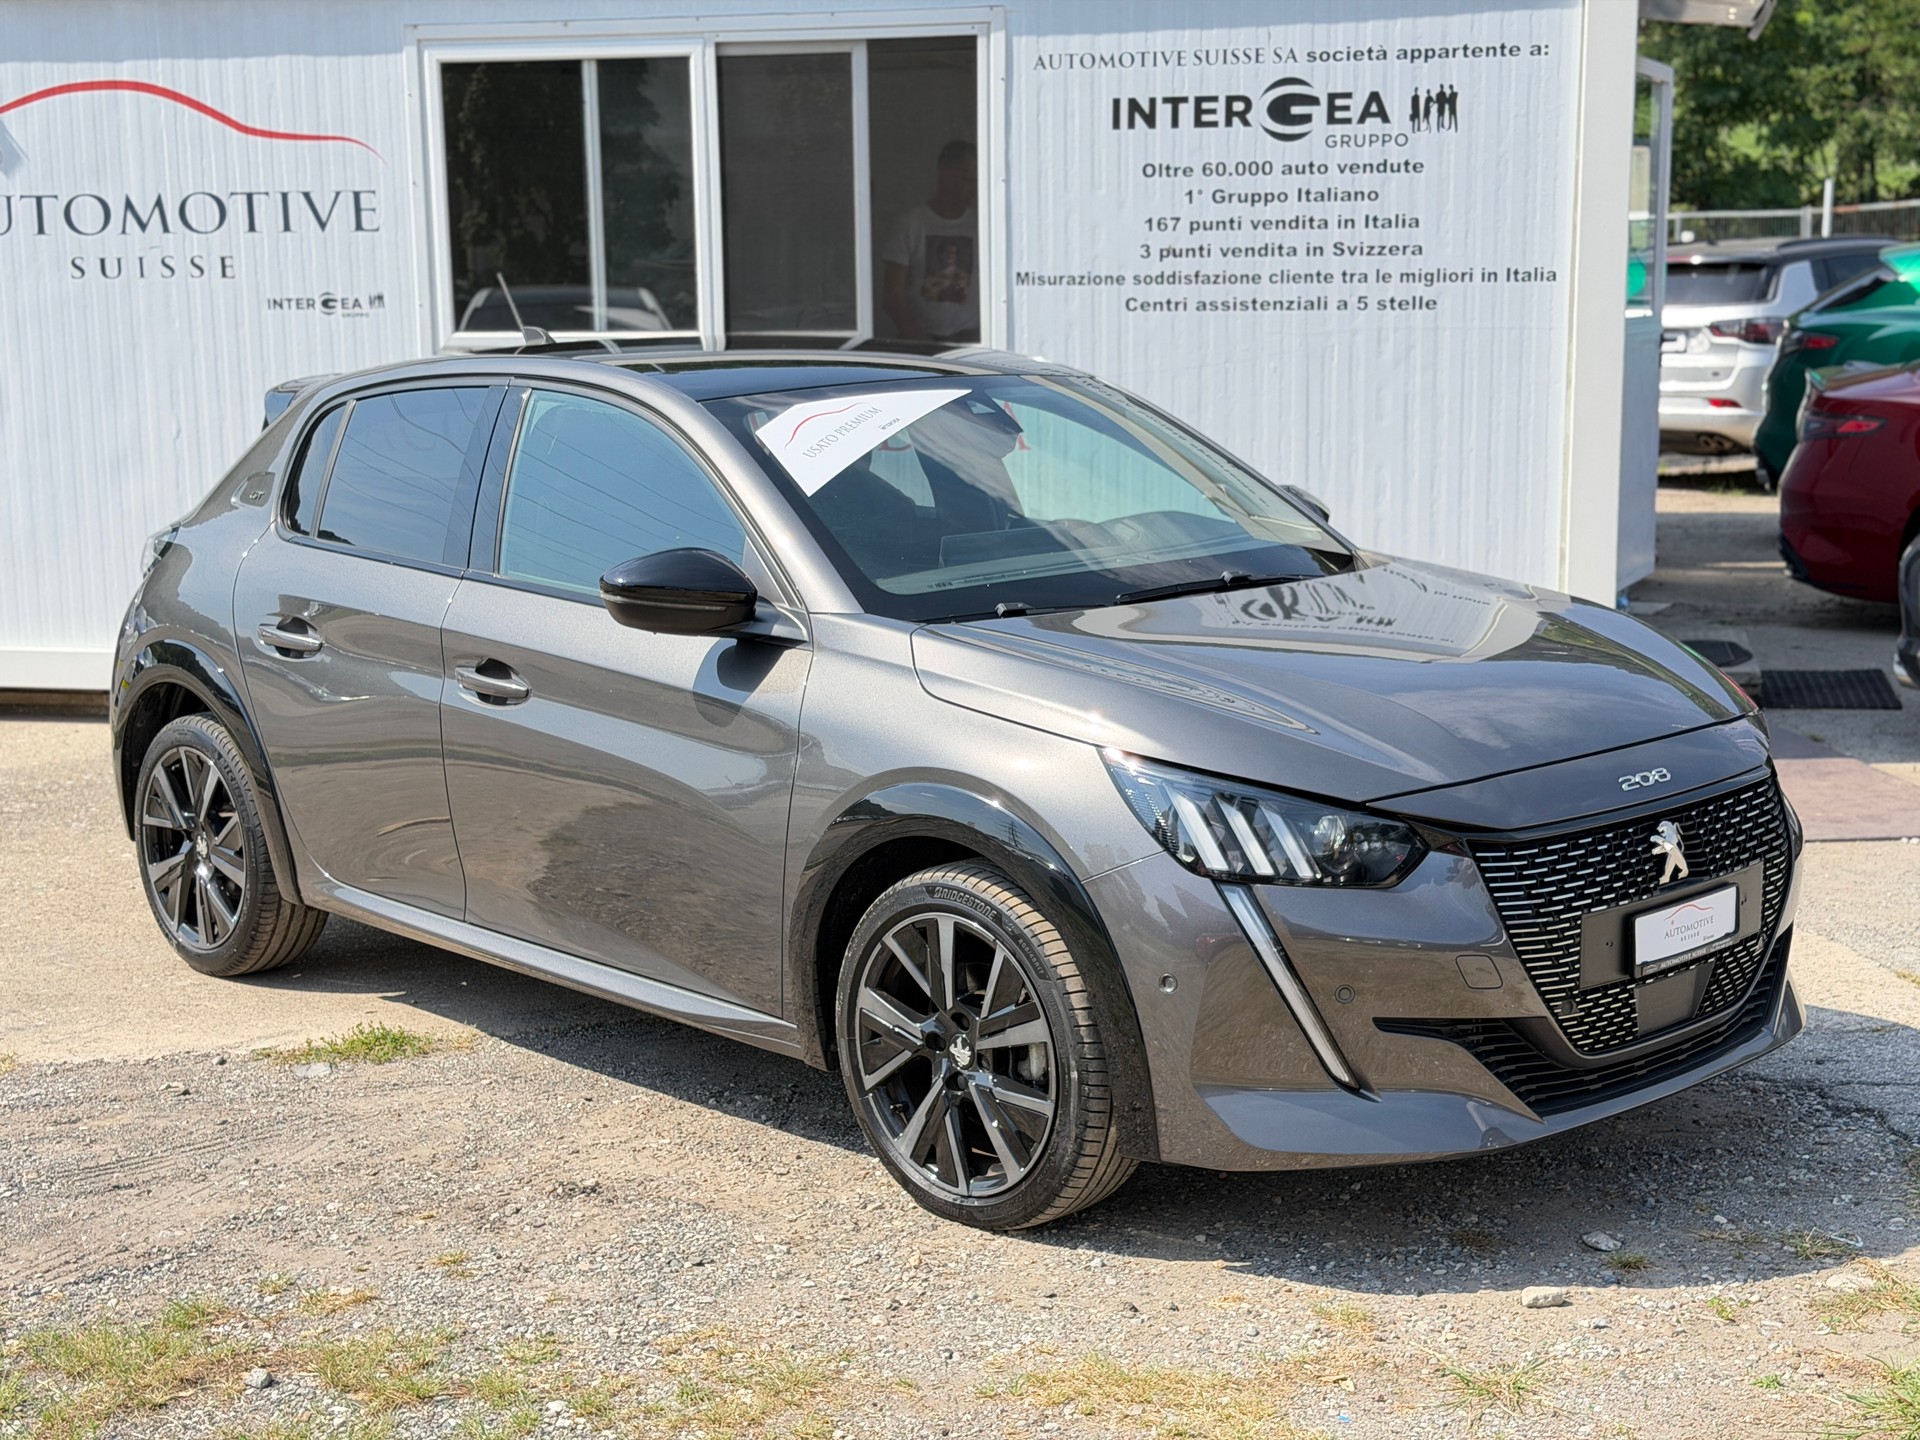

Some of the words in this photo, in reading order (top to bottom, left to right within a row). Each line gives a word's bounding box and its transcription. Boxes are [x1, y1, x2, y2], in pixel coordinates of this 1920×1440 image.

[1033, 50, 1187, 70] AUTOMOTIVE
[1192, 47, 1265, 66] SUISSE
[1272, 47, 1299, 64] SA
[1306, 45, 1388, 62] società
[1396, 42, 1521, 64] appartente
[1529, 44, 1550, 57] a:
[1325, 133, 1409, 148] GRUPPO
[1142, 163, 1194, 178] Oltre
[1202, 160, 1273, 177] 60.000
[1281, 160, 1329, 176] auto
[1337, 158, 1425, 175] vendute
[1211, 188, 1289, 208] Gruppo
[1297, 187, 1379, 203] Italiano
[1145, 217, 1181, 232] 167
[1189, 216, 1243, 236] punti
[1250, 215, 1330, 231] vendita
[1337, 214, 1356, 230] in
[1364, 213, 1420, 229] Italia
[1140, 244, 1151, 259] 3
[1159, 244, 1212, 263] punti
[1219, 242, 1298, 258] vendita
[1306, 241, 1325, 257] in
[1333, 241, 1424, 257] Svizzera
[71, 255, 236, 280] SUISSE
[1015, 270, 1126, 287] Misurazione
[1132, 268, 1262, 286] soddisfazione
[1269, 268, 1335, 285] cliente
[1342, 268, 1369, 284] tra
[1376, 268, 1393, 284] le
[1399, 266, 1474, 288] migliori
[1482, 267, 1499, 283] in
[1506, 266, 1558, 282] Italia
[1125, 297, 1188, 312] Centri
[1195, 295, 1329, 312] assistenziali
[1336, 298, 1349, 311] a
[1356, 296, 1369, 311] 5
[1377, 295, 1438, 311] stelle
[802, 434, 839, 458] USATO
[834, 406, 883, 437] PREMIUM
[1618, 767, 1672, 791] 208
[933, 886, 997, 920] BRIDGESTONE
[1664, 915, 1715, 939] AUTOMOTIVE
